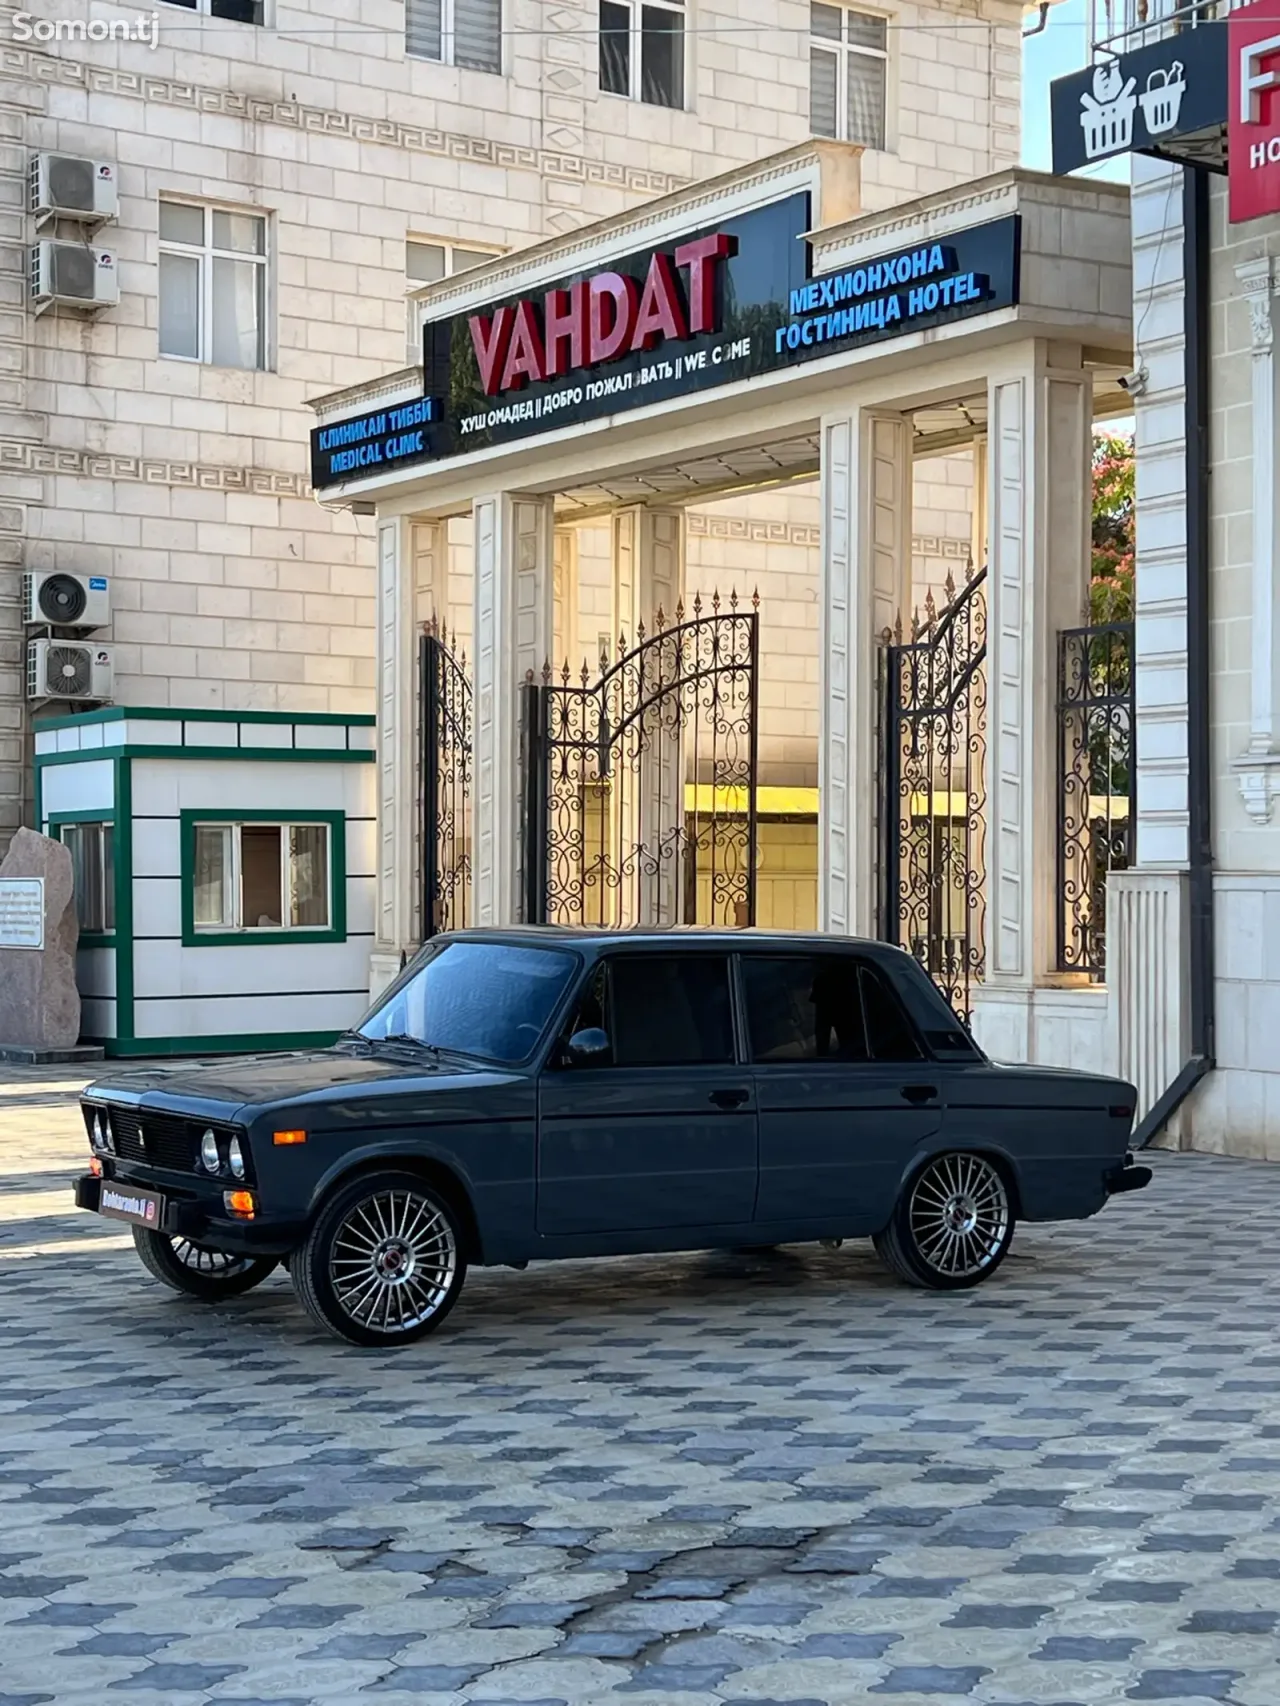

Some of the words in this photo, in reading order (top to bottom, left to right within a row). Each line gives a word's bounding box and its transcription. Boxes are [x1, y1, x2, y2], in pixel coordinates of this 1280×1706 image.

[468, 233, 721, 395] VAHDAT
[775, 295, 901, 353] ГОСТИНИЦА
[909, 272, 980, 317] HOTEL
[460, 413, 486, 435] ХУШ
[487, 400, 534, 424] ОМАДЕД
[543, 387, 582, 414] ДОБРО
[330, 443, 383, 474] MEDICAL
[385, 430, 424, 459] CLINIC
